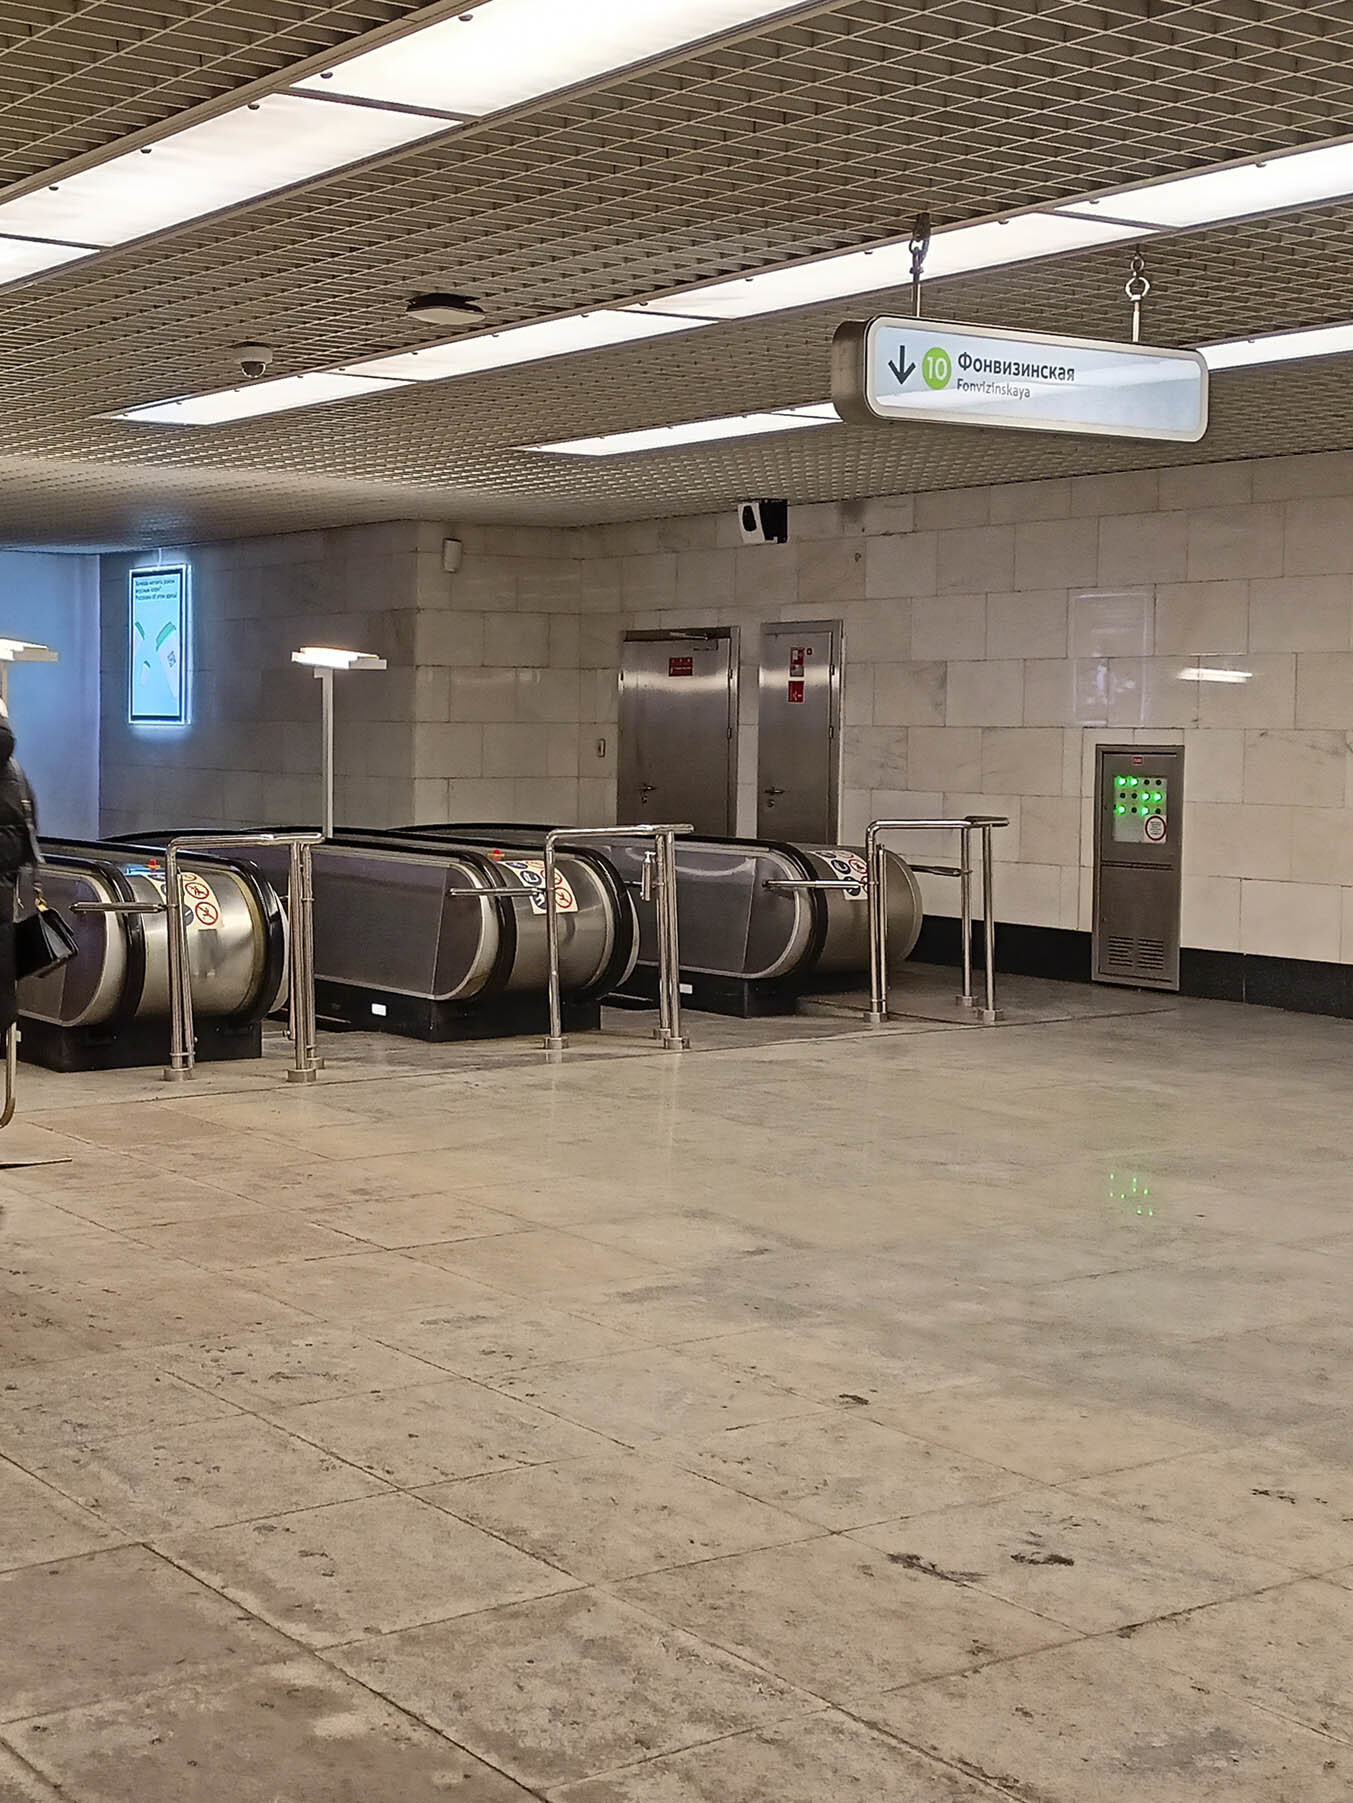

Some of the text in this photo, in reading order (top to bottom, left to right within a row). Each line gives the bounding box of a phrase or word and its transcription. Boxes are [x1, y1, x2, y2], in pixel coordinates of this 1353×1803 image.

[926, 351, 1076, 382] 10 Фонвизинская
[957, 378, 1031, 400] Fonvizinskaya
